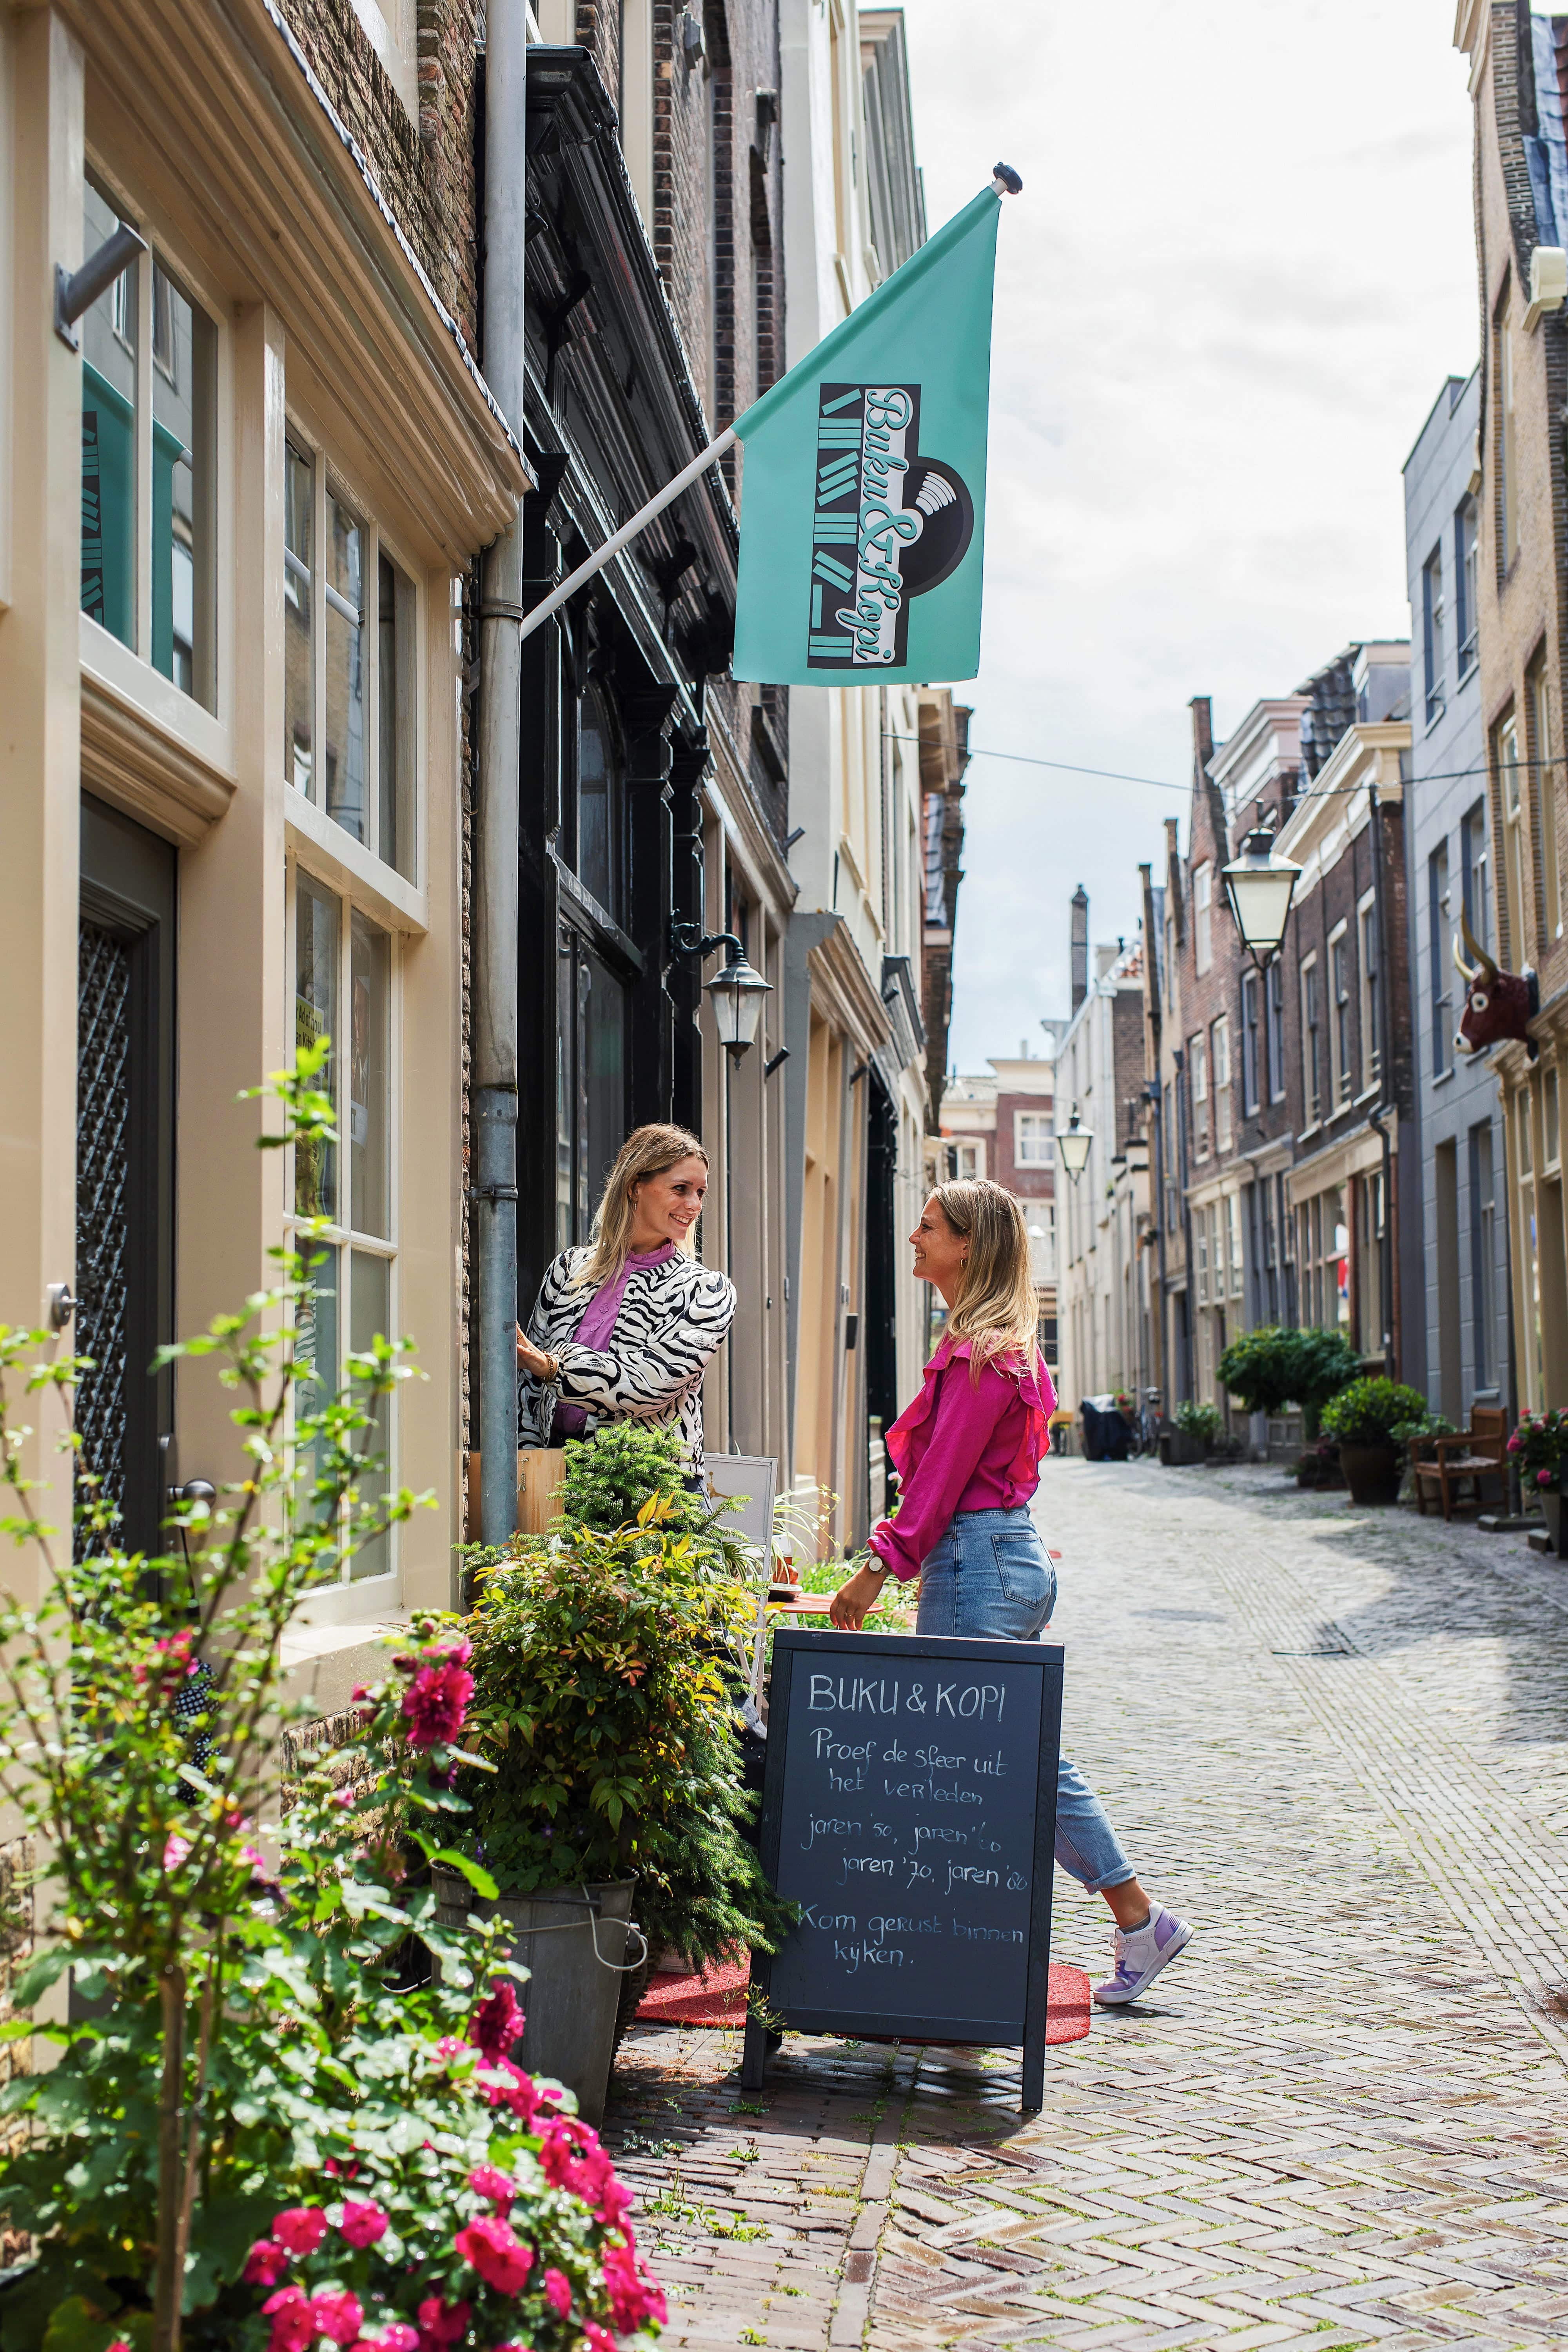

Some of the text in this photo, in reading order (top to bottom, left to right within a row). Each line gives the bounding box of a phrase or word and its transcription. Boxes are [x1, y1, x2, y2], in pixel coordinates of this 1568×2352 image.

[808, 1675, 898, 1715] BUKU
[906, 1683, 927, 1714] &
[809, 1728, 1008, 1781] Proef de sfeer uit
[829, 1767, 866, 1792] het
[801, 1813, 862, 1850] jaren
[907, 1813, 967, 1855] jaren
[836, 1847, 894, 1886] jaren
[944, 1859, 999, 1895] jaren
[798, 1903, 856, 1932] Kom
[953, 1916, 1024, 1944] binnen
